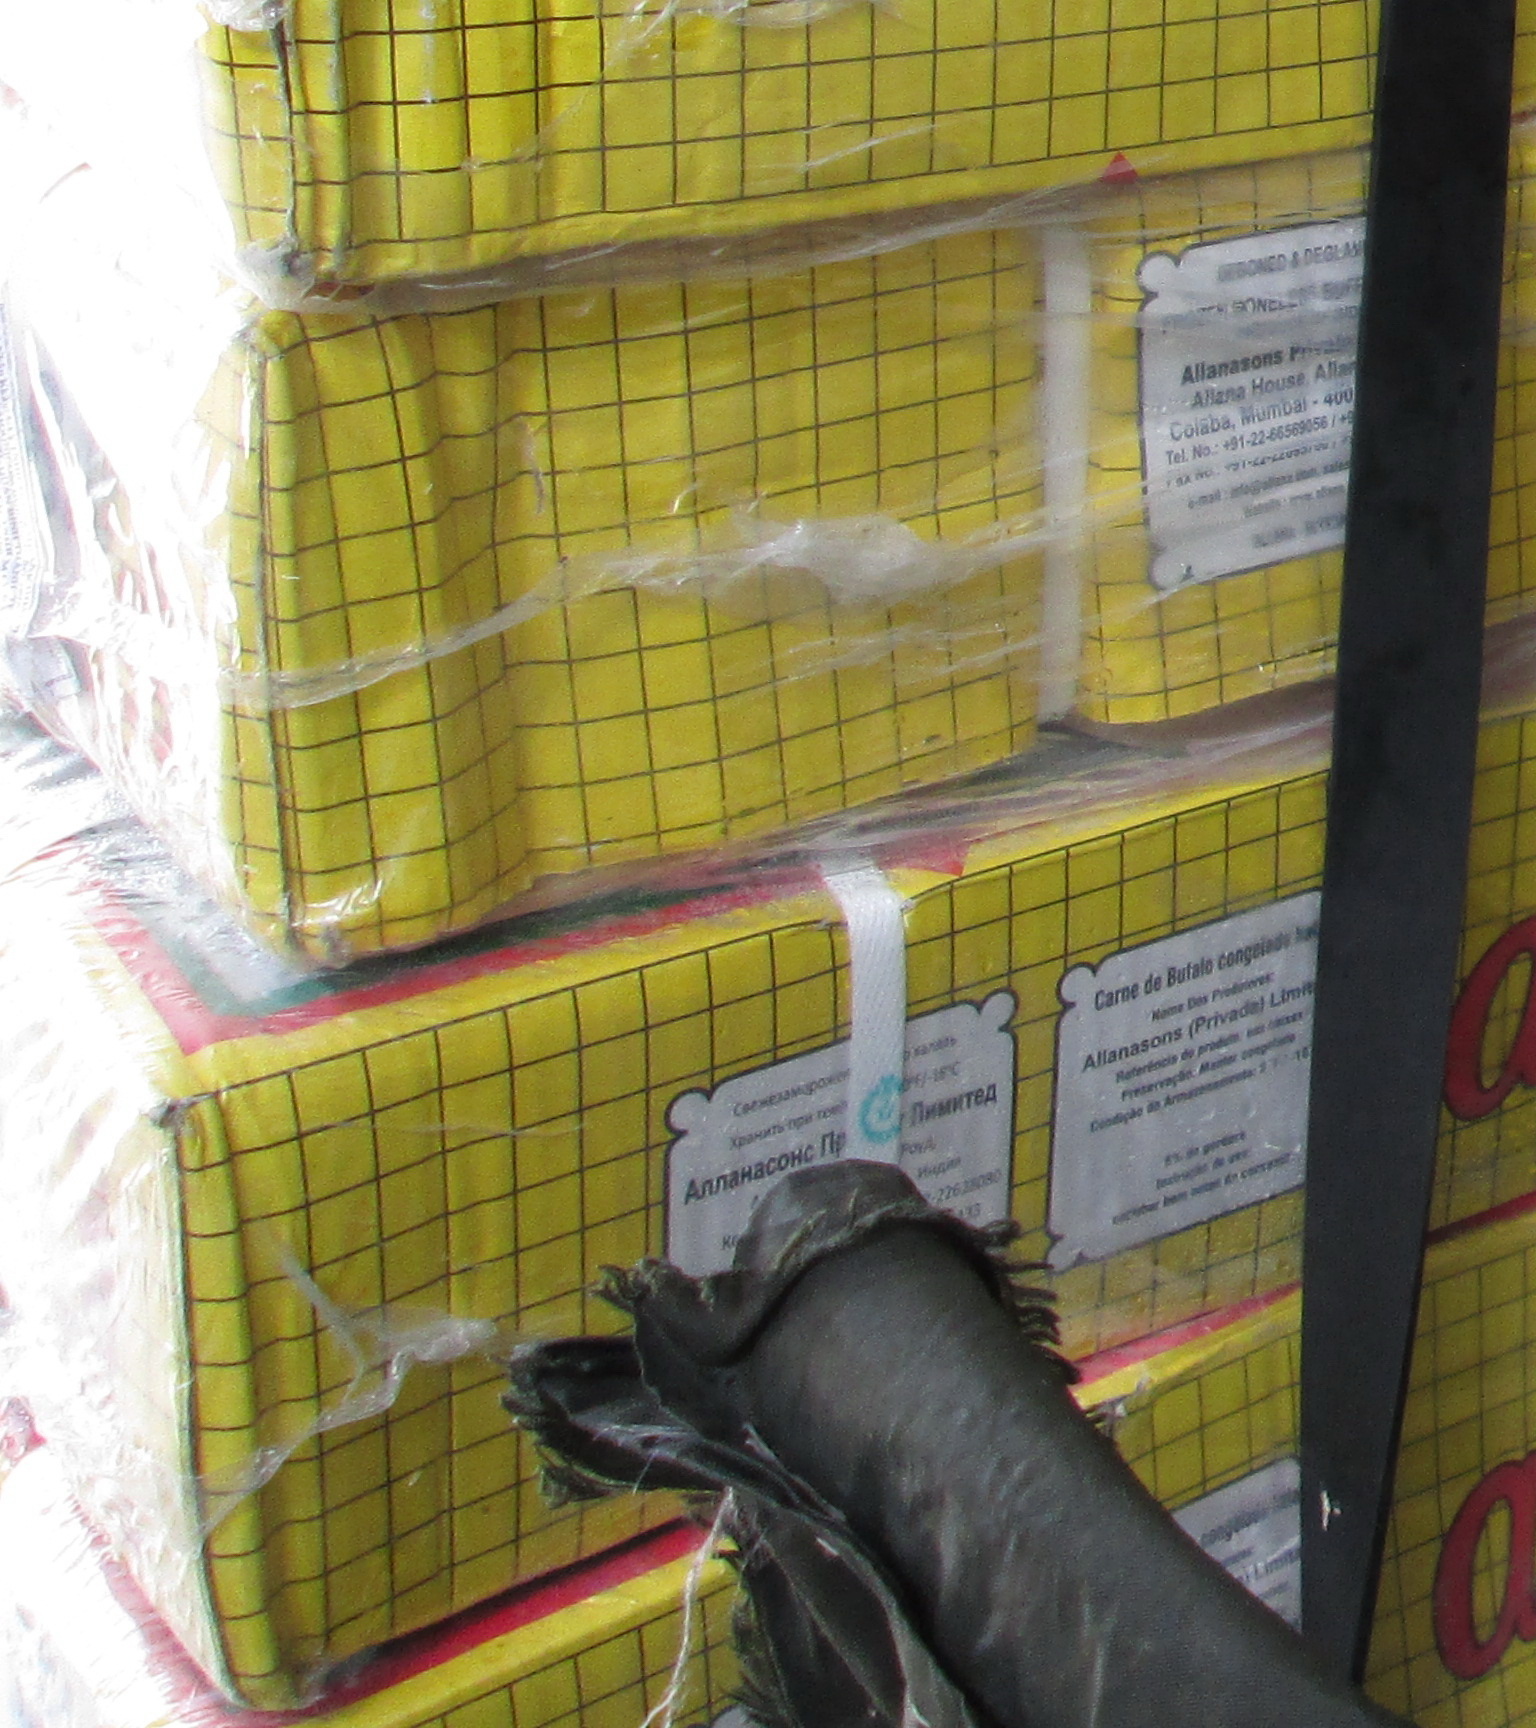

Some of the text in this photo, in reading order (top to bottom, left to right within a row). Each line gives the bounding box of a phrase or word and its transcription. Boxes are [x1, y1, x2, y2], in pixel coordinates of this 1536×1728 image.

[1181, 347, 1284, 386] Allanasons
[1191, 385, 1246, 409] Allana
[1170, 412, 1236, 442] Colaba,
[1240, 396, 1308, 427] Mumbai
[1094, 980, 1140, 1012] Carne
[1143, 973, 1162, 996] de
[1083, 1026, 1184, 1073] Allanasons
[684, 1143, 815, 1207] Алланасонс
[910, 1082, 998, 1127] Лимитед
